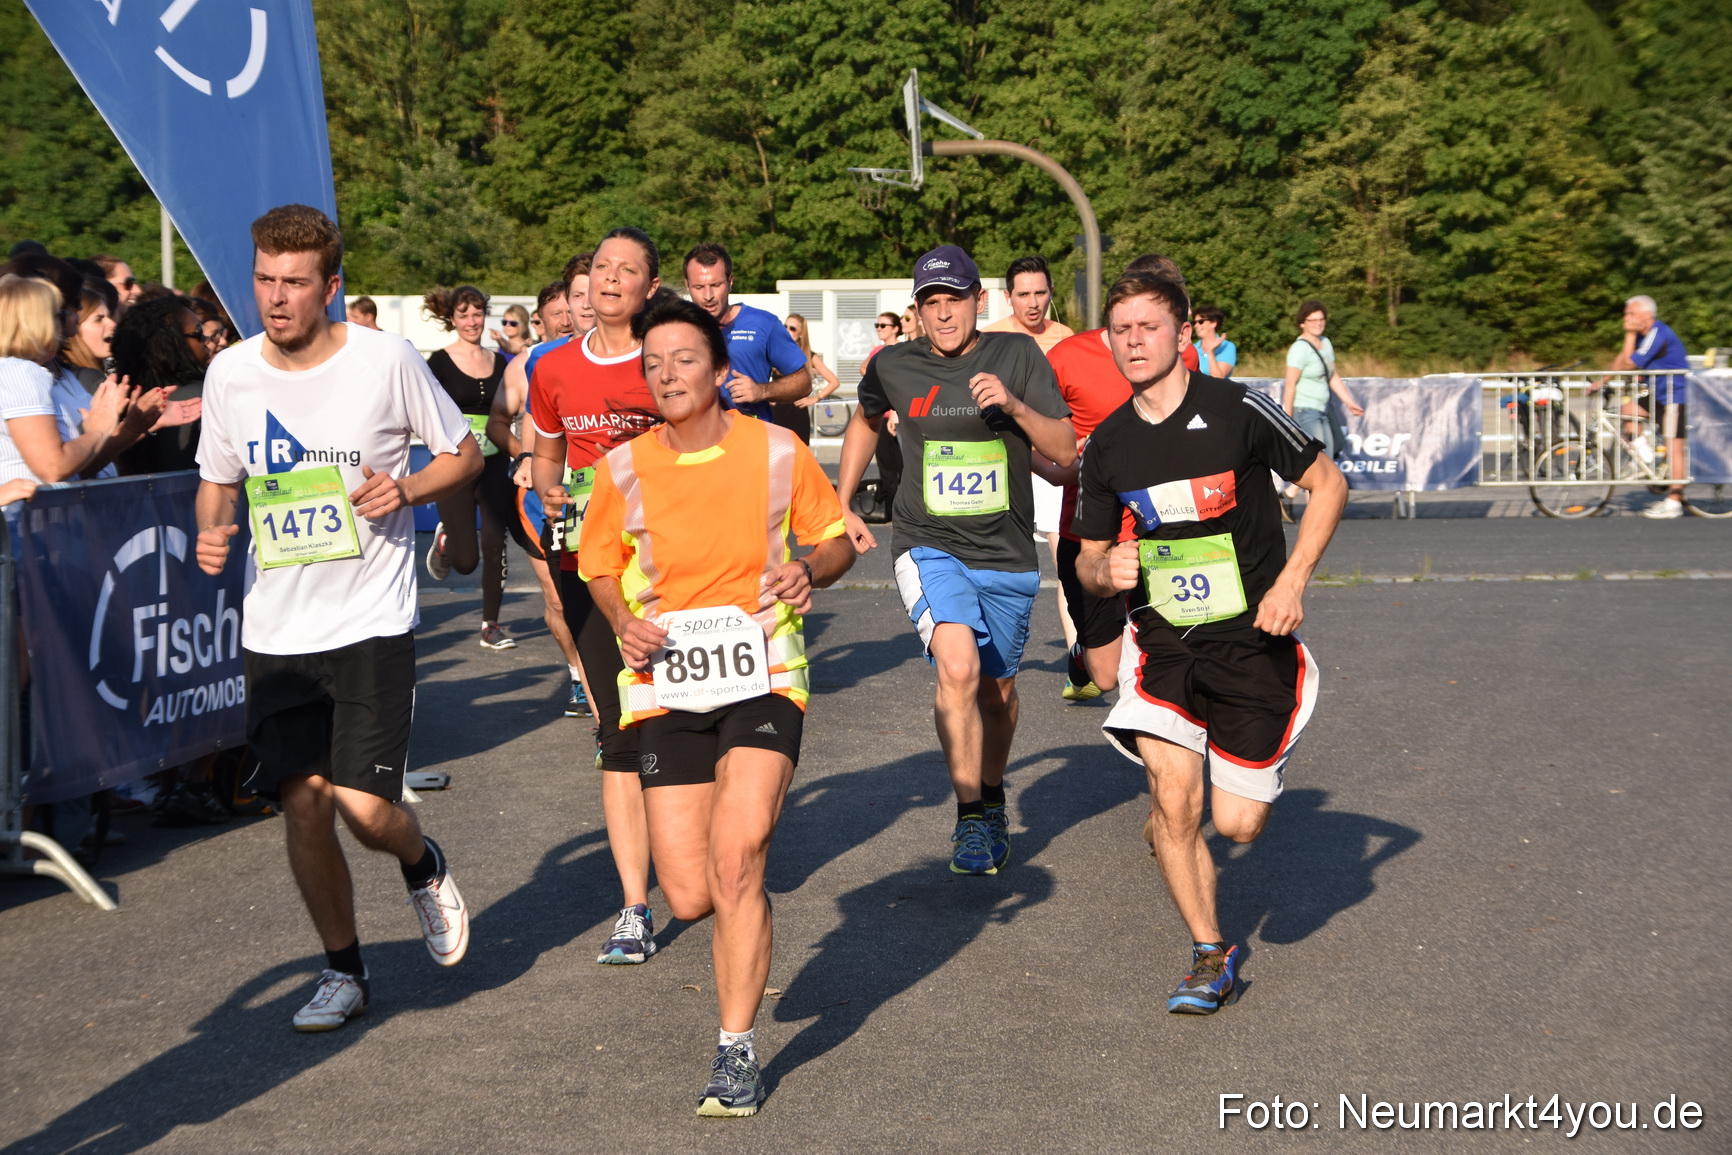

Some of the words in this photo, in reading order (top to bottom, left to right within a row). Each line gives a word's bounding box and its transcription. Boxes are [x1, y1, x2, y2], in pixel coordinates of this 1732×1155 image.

[561, 412, 645, 431] NEUMARKT
[1335, 460, 1398, 473] OBILE
[932, 470, 997, 495] 1421
[263, 504, 342, 541] 1473
[279, 544, 308, 553] Sebastian
[1171, 573, 1211, 602] 39
[132, 588, 240, 683] Fisch
[657, 614, 744, 634] df-sports
[664, 641, 756, 684] 8916
[143, 675, 246, 728] AUTOMOB
[660, 682, 765, 700] www.df-sports.de
